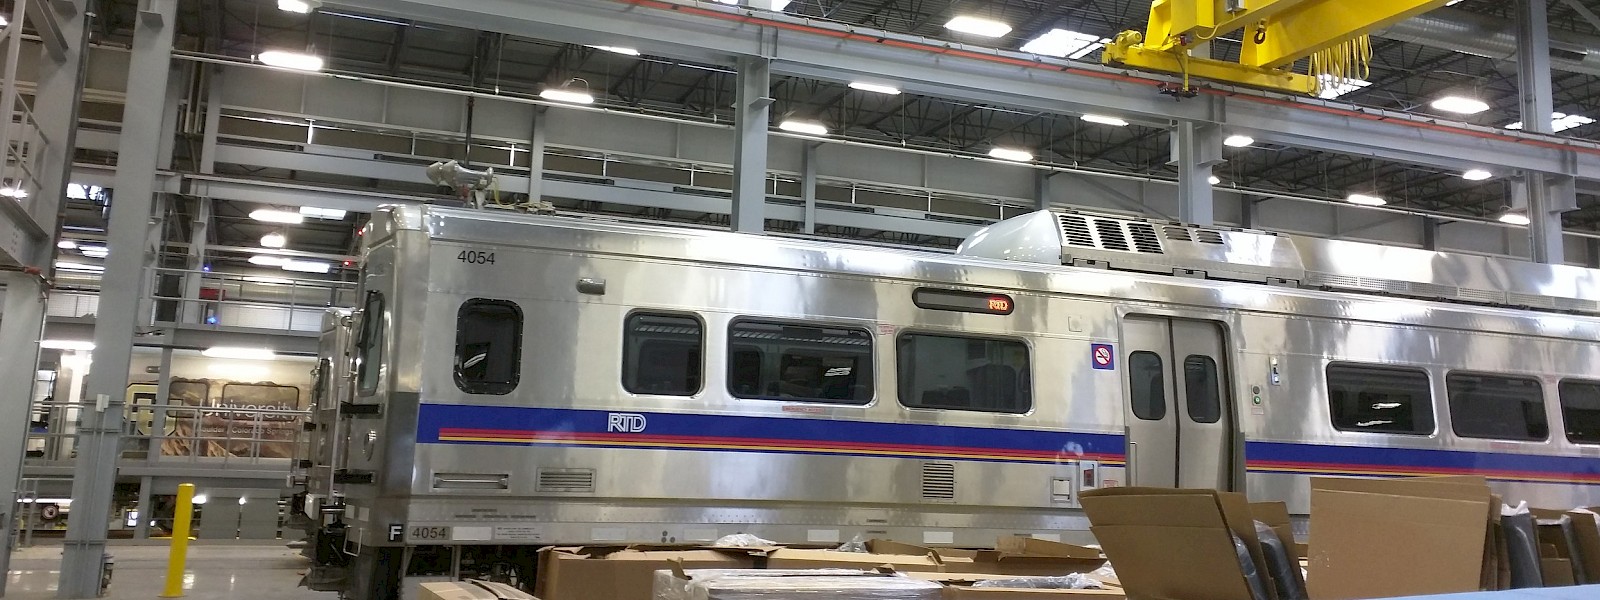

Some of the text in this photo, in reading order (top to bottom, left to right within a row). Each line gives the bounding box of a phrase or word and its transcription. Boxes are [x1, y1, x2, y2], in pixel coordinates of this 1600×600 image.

[457, 250, 496, 265] 4054
[988, 299, 1009, 311] RTD
[200, 398, 299, 424] University
[607, 412, 647, 432] RTD
[198, 426, 225, 434] oulder
[390, 525, 402, 540] F
[412, 526, 446, 539] 4054
